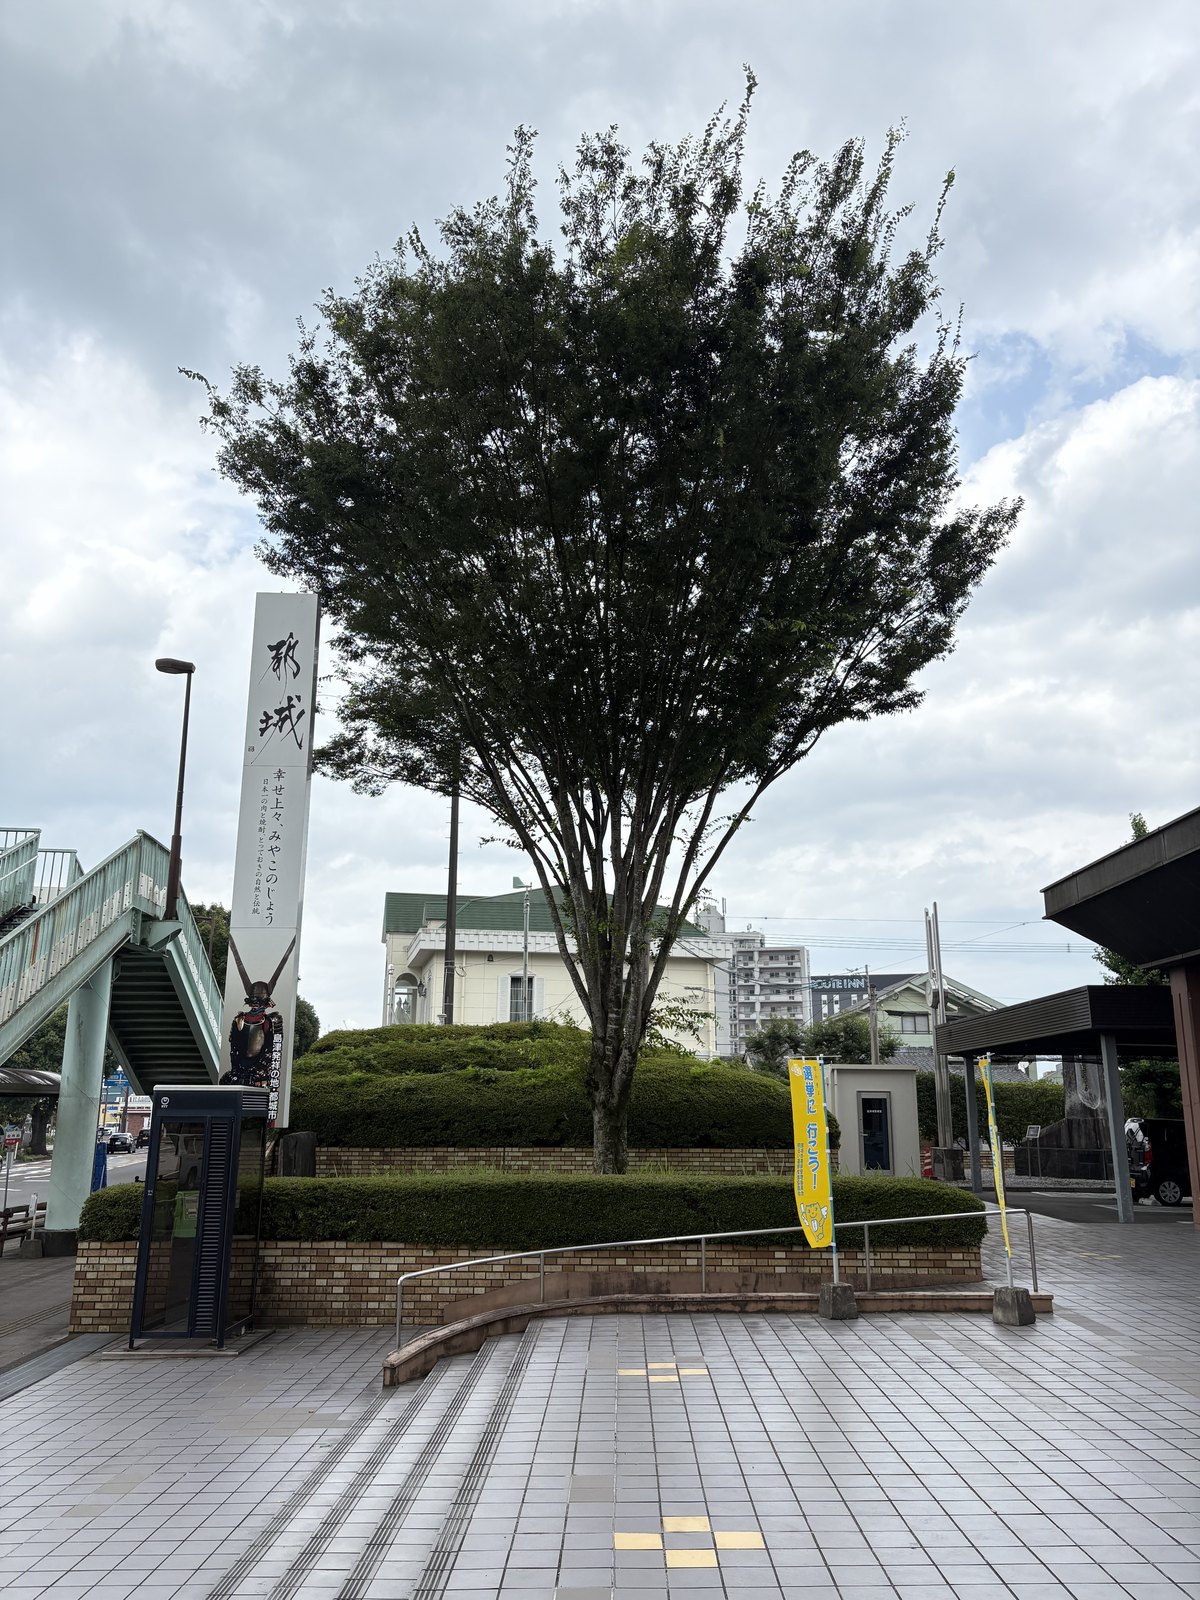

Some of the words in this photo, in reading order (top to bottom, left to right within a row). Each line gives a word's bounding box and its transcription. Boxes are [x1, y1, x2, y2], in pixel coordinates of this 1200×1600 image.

[249, 632, 306, 764] 都城
[265, 768, 286, 926] 幸せ上々、みやこのじょう
[843, 978, 865, 989] INN
[267, 1033, 282, 1120] 島津発祥の地・都城市
